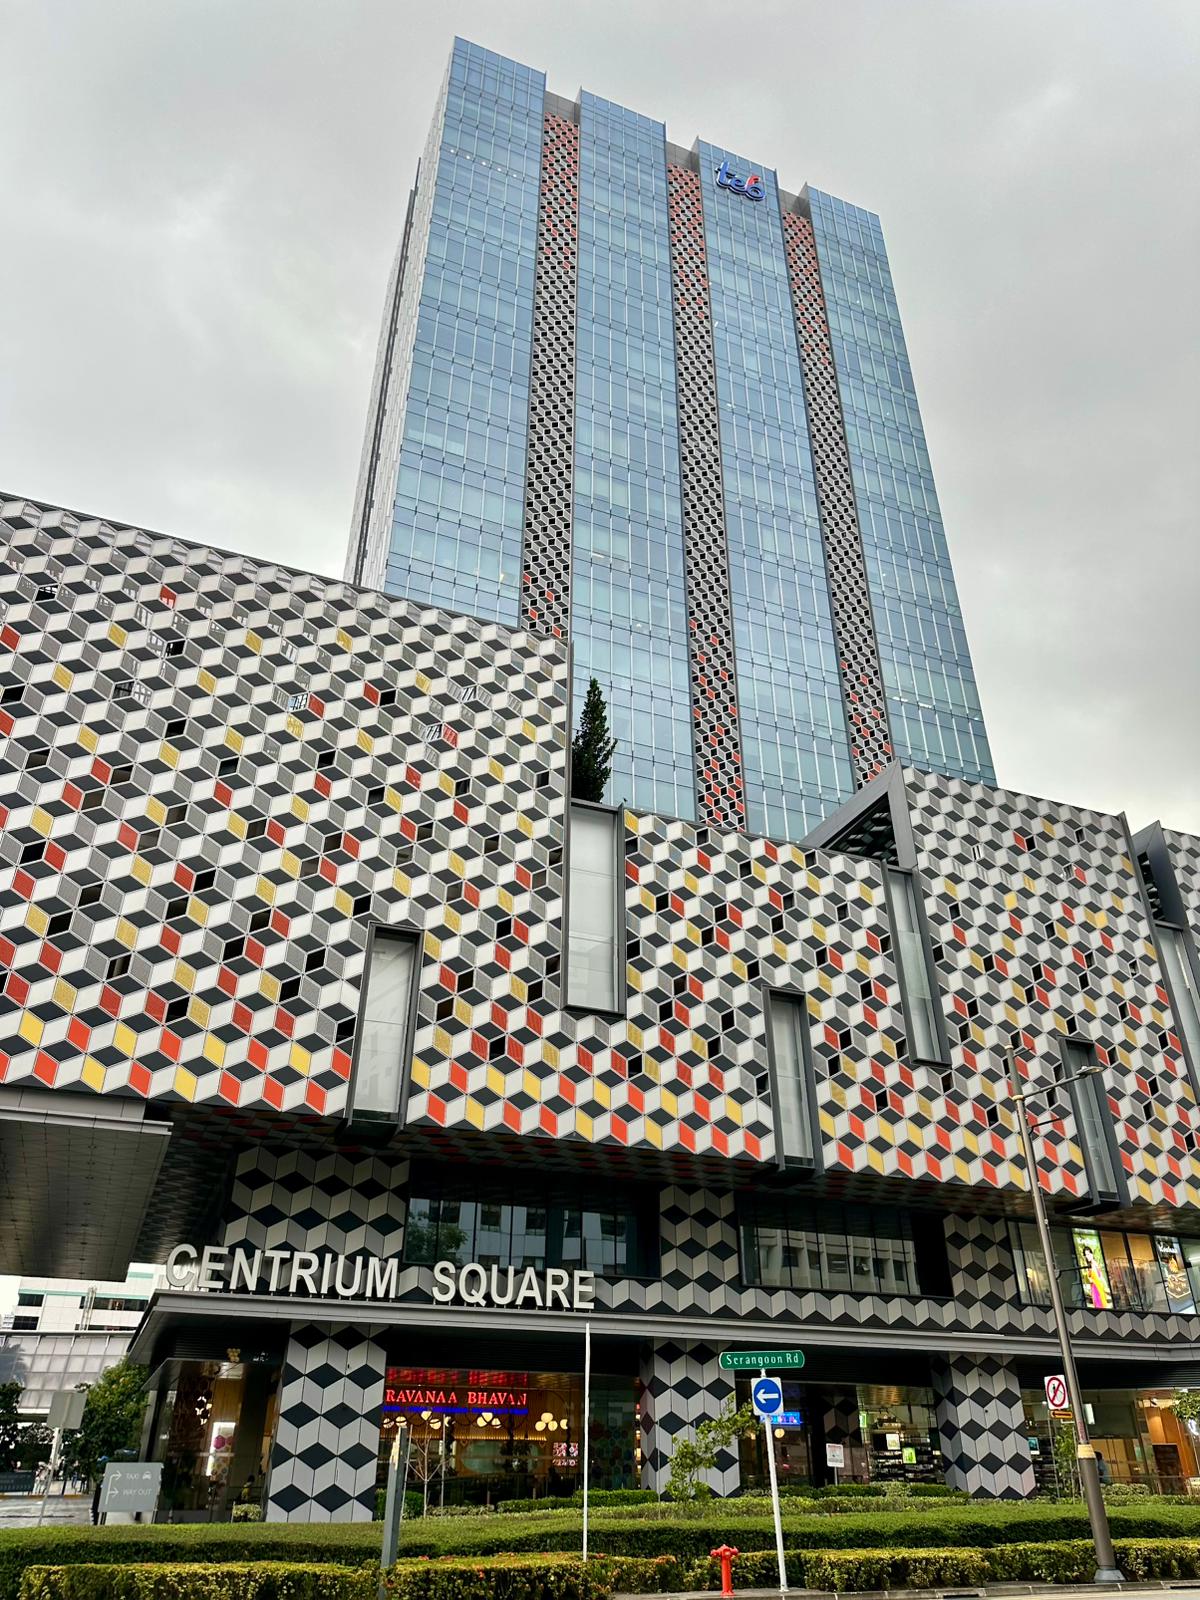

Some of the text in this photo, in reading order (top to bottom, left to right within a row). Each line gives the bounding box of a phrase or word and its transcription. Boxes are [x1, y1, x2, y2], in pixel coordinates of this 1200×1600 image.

[165, 1243, 595, 1310] CENTRIUM SQUARE
[726, 1353, 799, 1366] Serangoon Rd
[467, 1391, 527, 1406] BHAVAN
